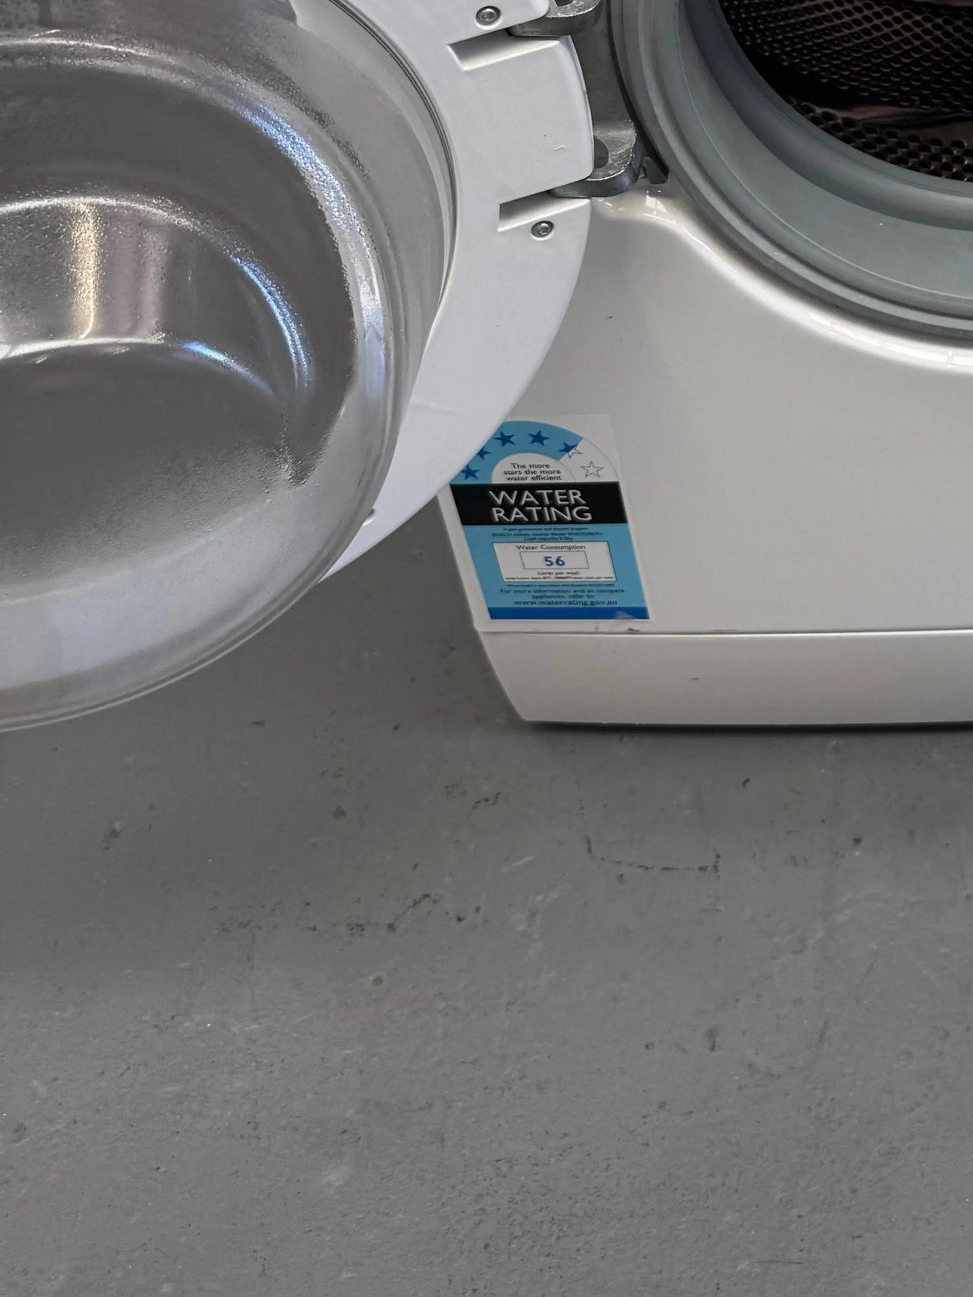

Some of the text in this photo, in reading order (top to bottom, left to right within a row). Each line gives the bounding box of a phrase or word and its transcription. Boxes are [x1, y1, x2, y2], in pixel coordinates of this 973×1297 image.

[488, 489, 587, 505] WATER
[491, 505, 593, 522] RATING
[543, 555, 566, 568] 56
